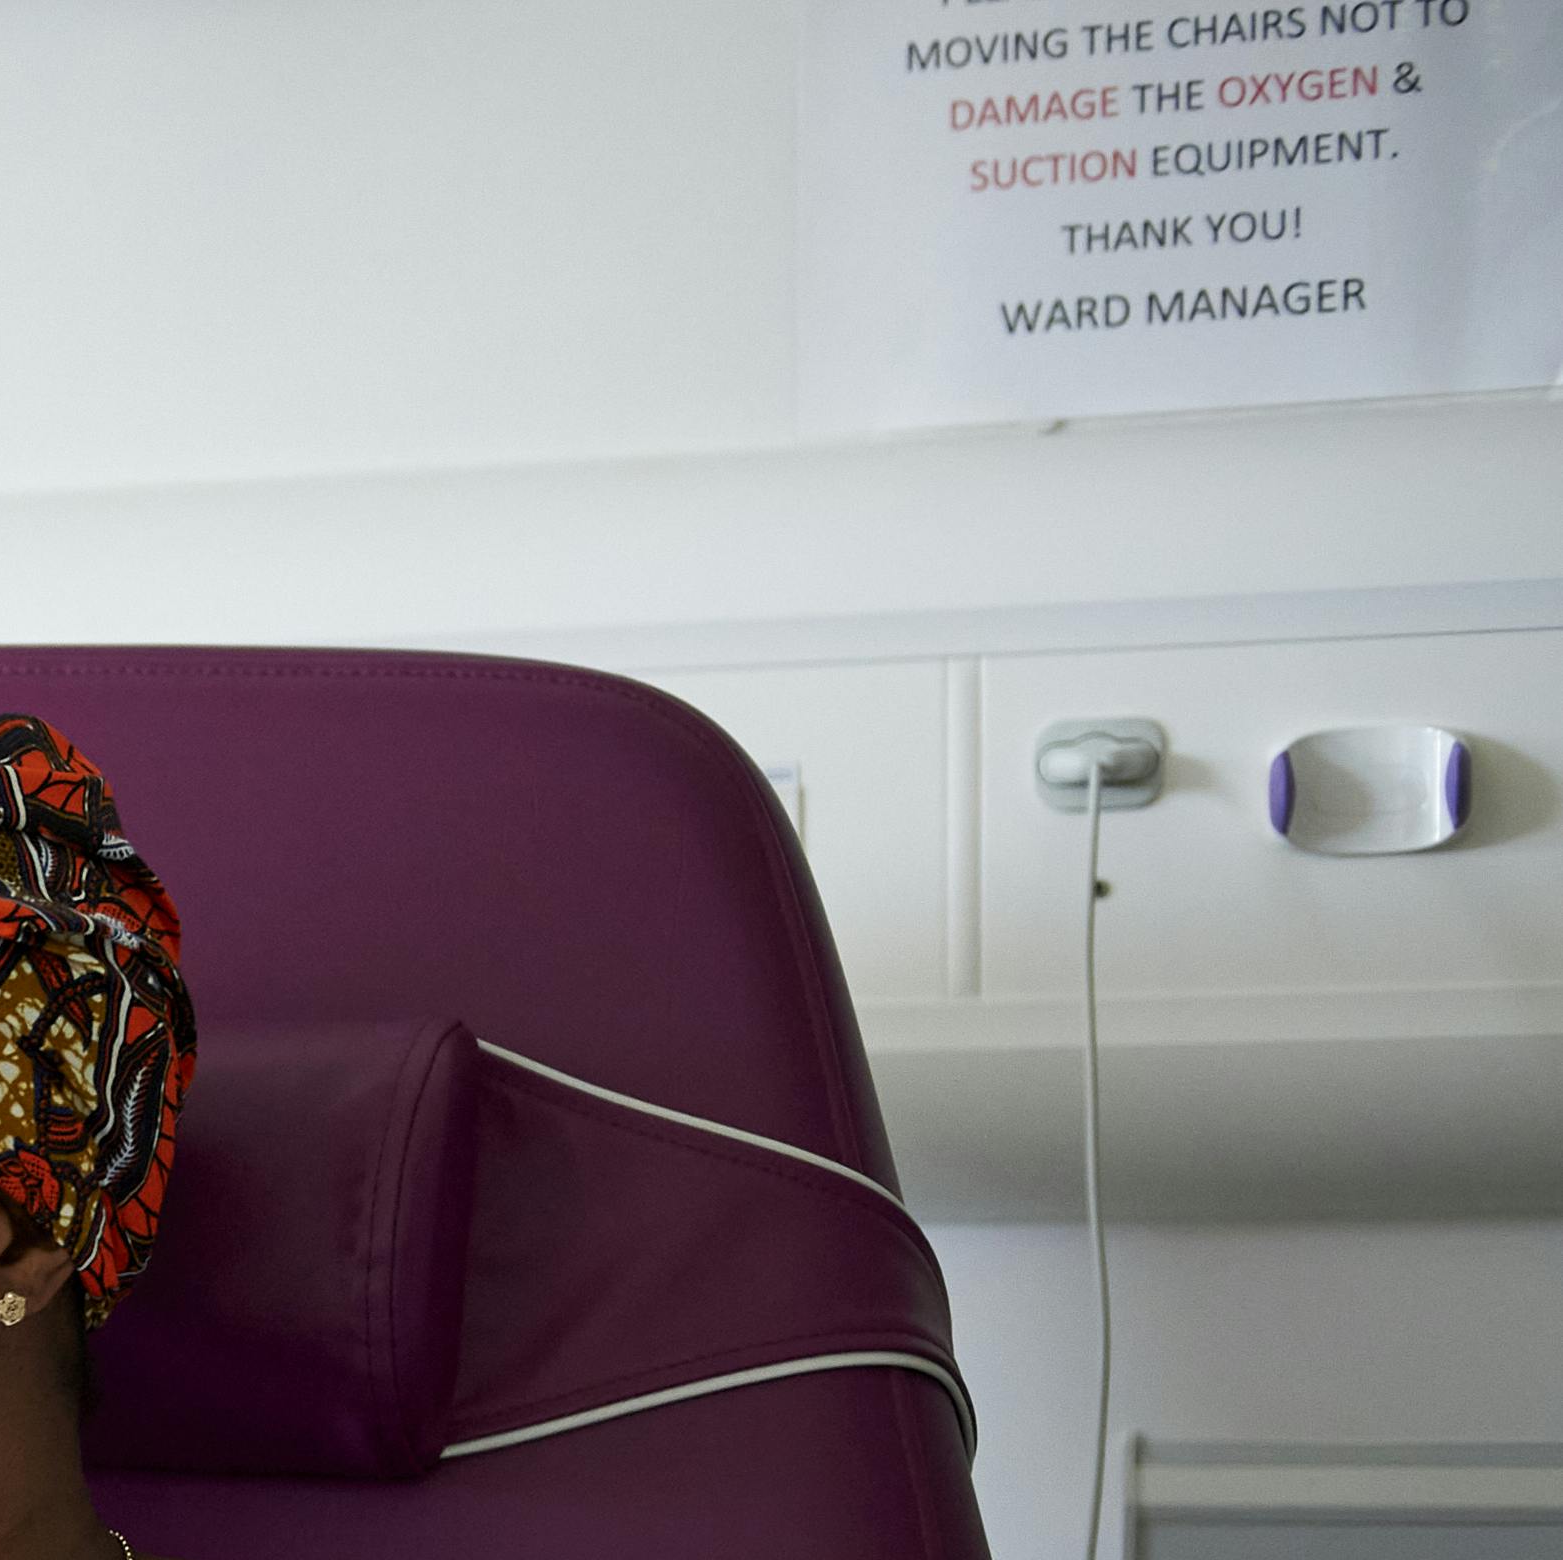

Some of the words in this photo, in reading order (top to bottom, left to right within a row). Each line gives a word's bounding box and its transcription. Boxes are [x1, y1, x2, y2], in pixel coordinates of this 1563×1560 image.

[906, 28, 1070, 72] MOVING
[1082, 22, 1154, 55] THE
[1167, 9, 1307, 50] CHAIRS
[1321, 1, 1400, 37] NOT
[1420, 0, 1470, 27] TO
[950, 86, 1120, 132] DAMAGE
[1133, 80, 1205, 116] THE
[1218, 66, 1380, 109] OXYGEN
[1393, 62, 1423, 94] &
[970, 149, 1138, 192] SUCTION
[1153, 129, 1400, 177] EQUIPMENT.
[1061, 216, 1194, 256] THANK
[1205, 207, 1304, 245] YOU!
[1000, 295, 1132, 335] WARD
[1148, 278, 1367, 326] MANAGER
